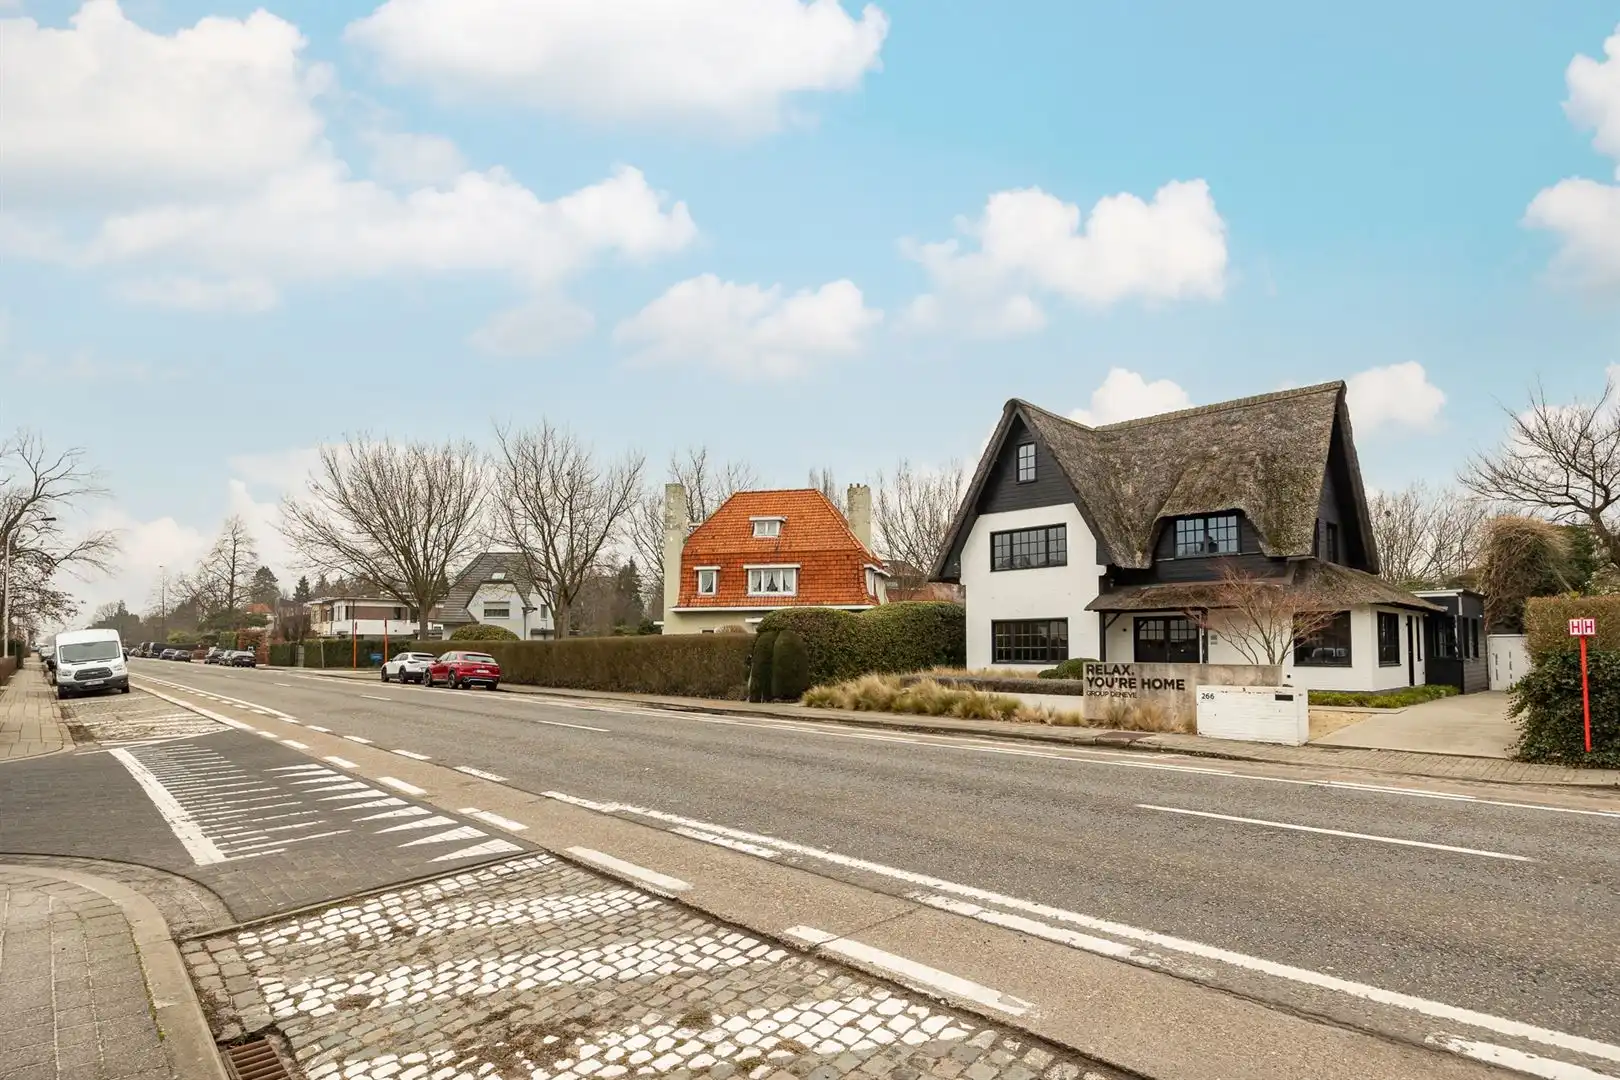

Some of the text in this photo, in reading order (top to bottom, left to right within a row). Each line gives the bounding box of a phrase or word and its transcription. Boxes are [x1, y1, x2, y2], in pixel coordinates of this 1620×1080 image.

[1086, 665, 1134, 675] RELAX.
[1086, 677, 1186, 691] YOU'RE HOME
[1201, 692, 1215, 700] 266
